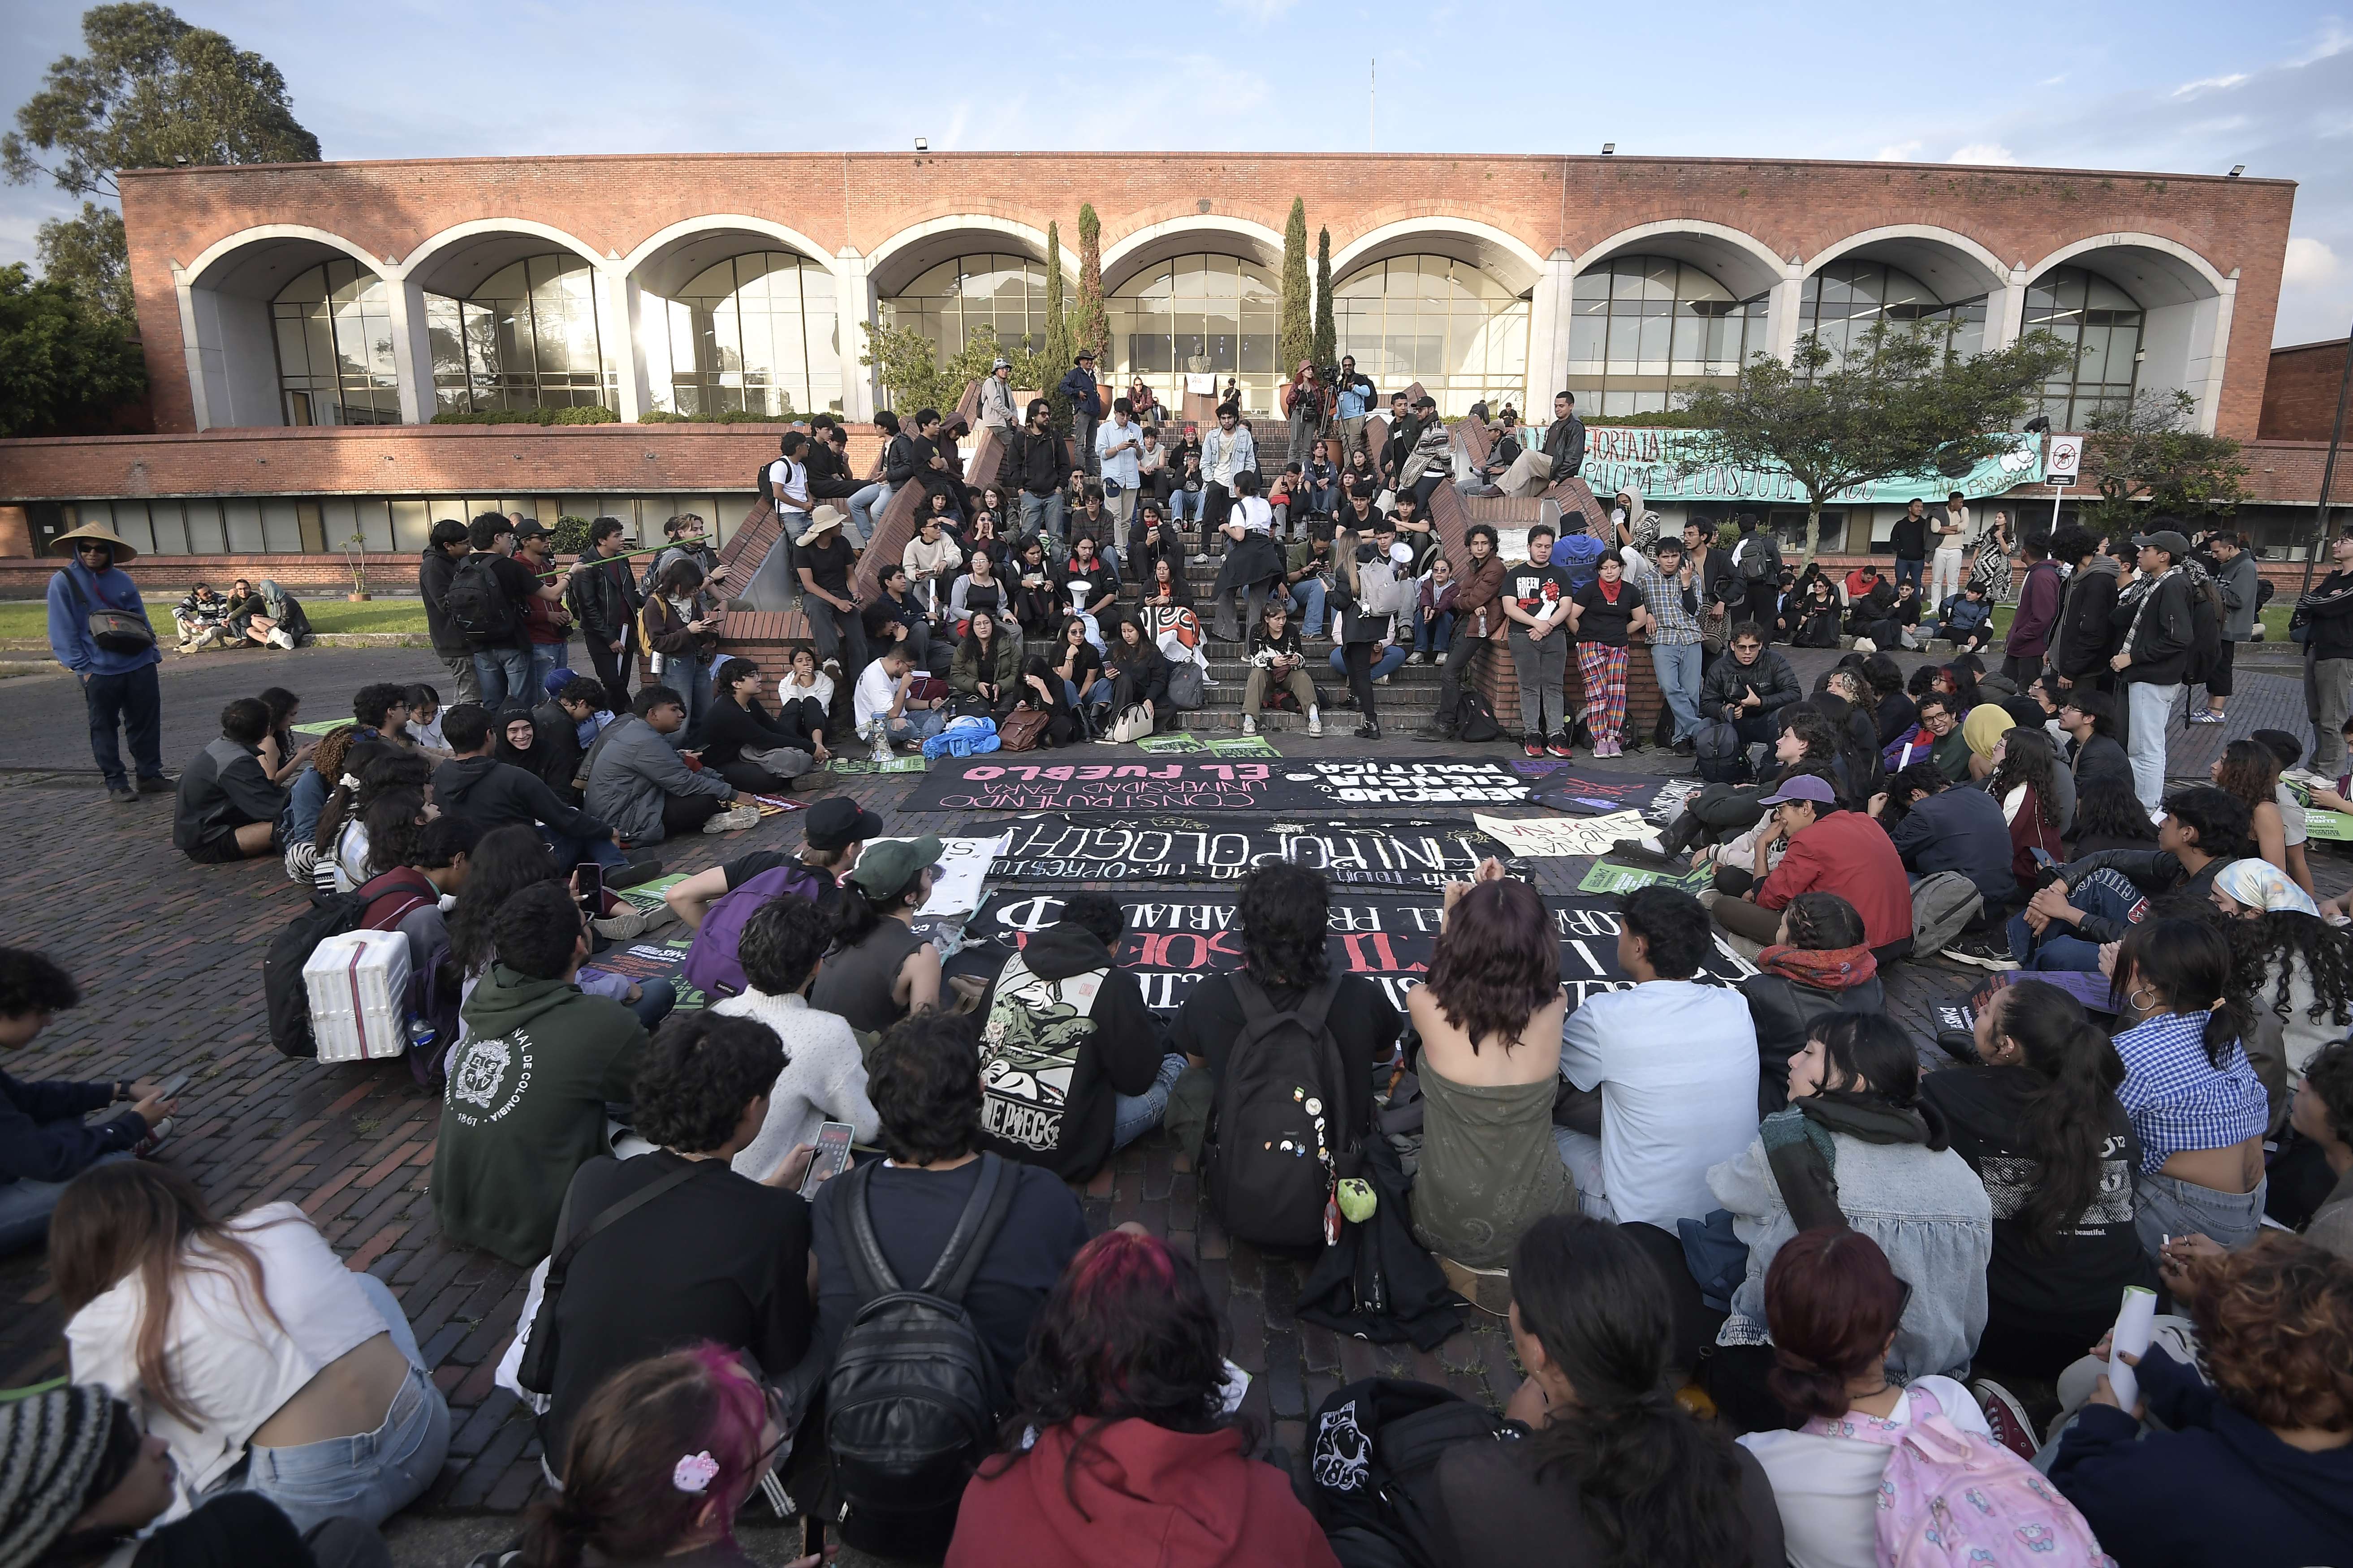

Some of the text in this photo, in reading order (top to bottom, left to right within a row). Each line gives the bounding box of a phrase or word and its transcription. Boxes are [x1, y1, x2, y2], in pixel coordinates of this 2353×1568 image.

[1694, 465, 1771, 498] CONSEJO
[1516, 577, 1540, 590] GREEN
[962, 763, 1270, 780] EL PUEBLO
[1313, 762, 1507, 777] POLÍTICA
[984, 780, 1268, 795] UNIVERSIDAD PARA
[1325, 774, 1520, 787] CIENCIA
[939, 792, 1255, 809] CONSTRUYENDO
[489, 1027, 533, 1122] NAL DE COLOMBIA
[457, 1112, 478, 1127] 1867
